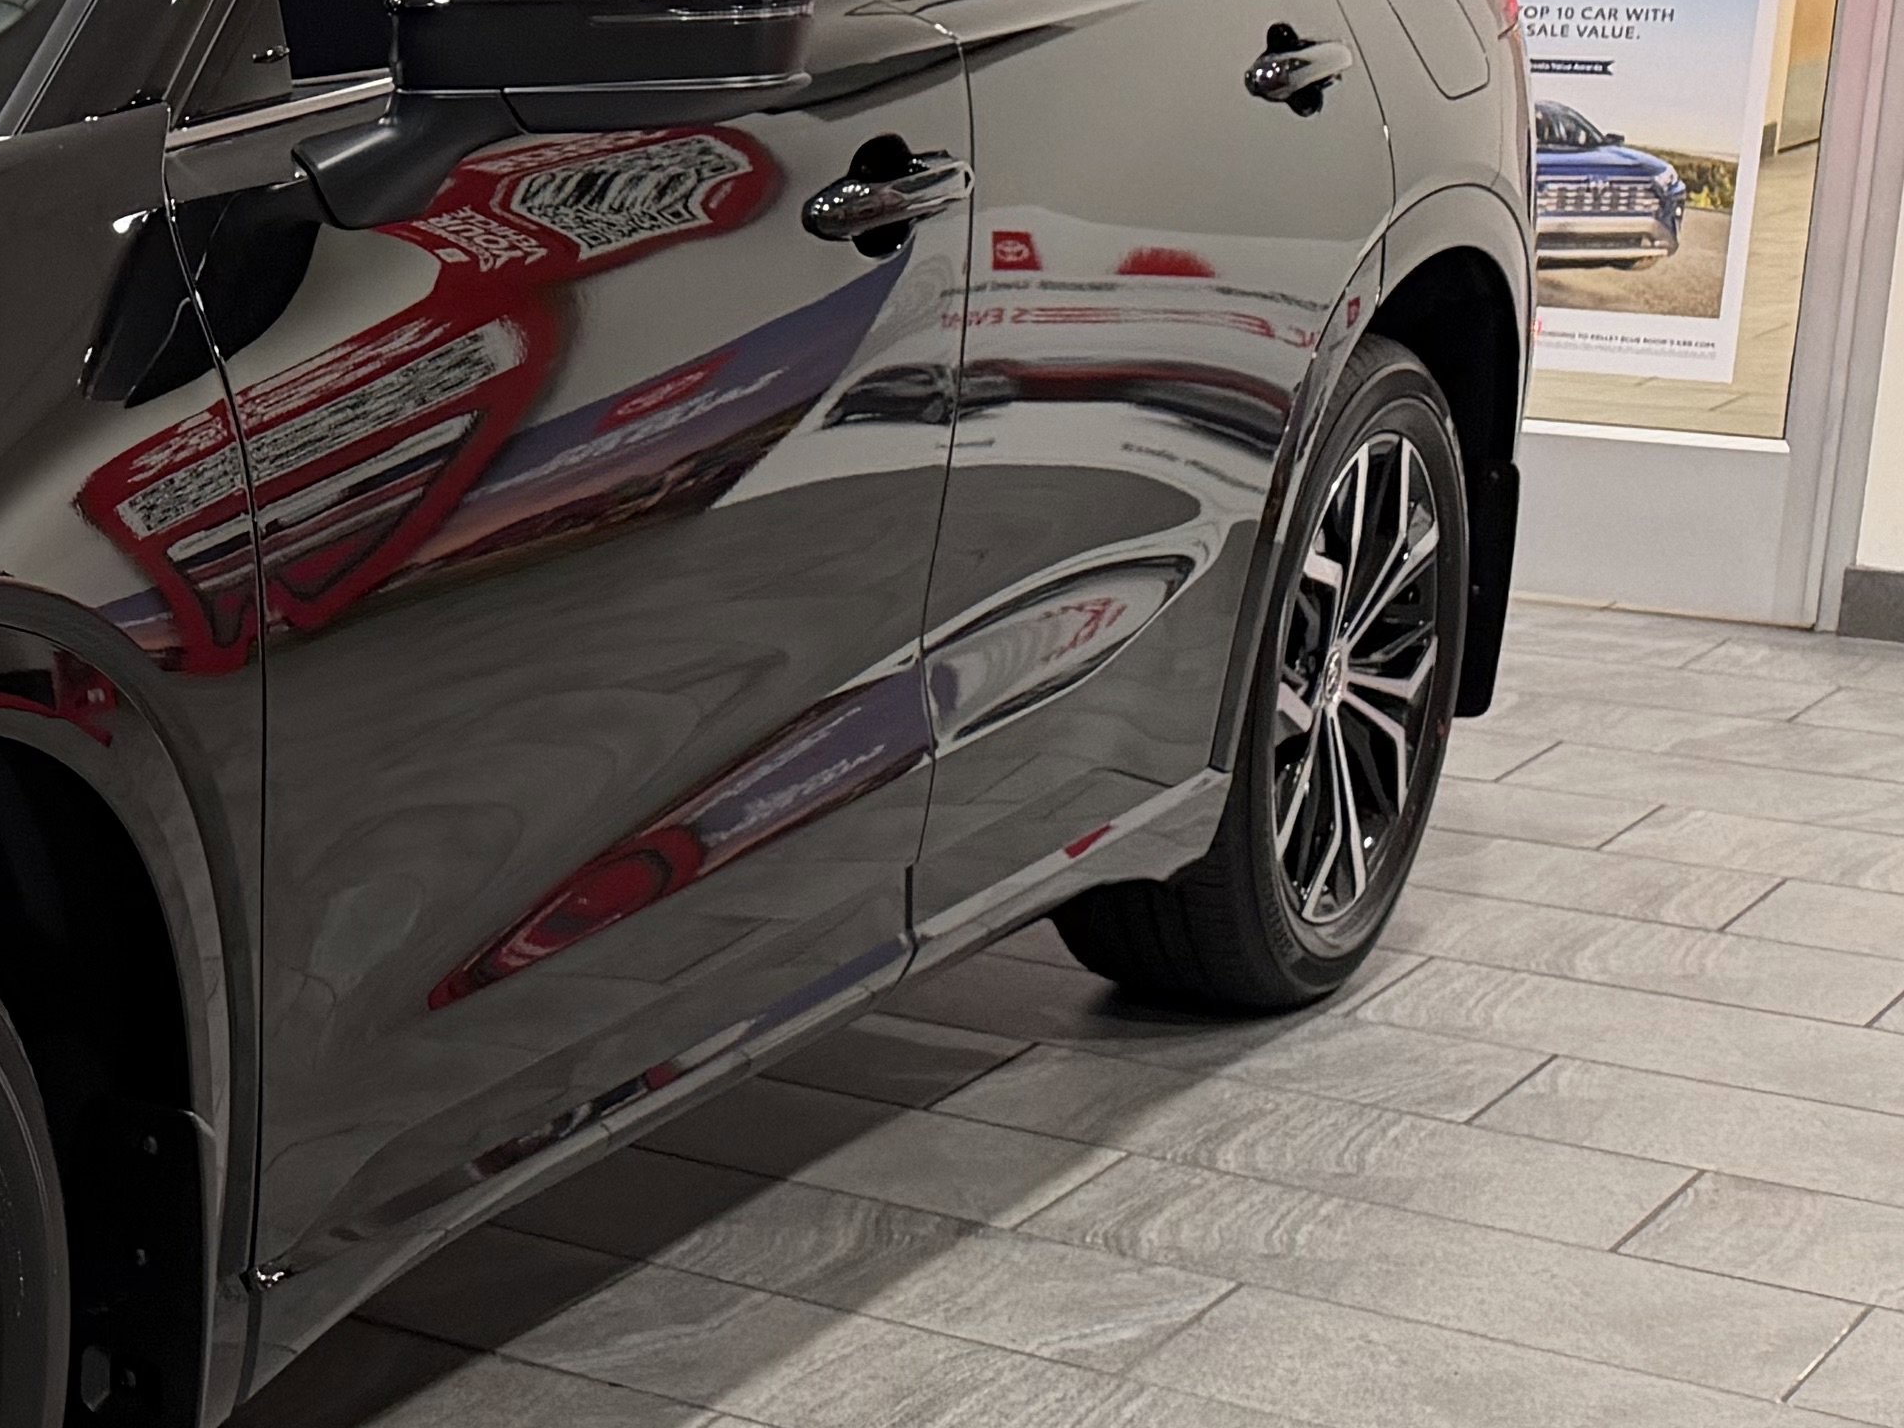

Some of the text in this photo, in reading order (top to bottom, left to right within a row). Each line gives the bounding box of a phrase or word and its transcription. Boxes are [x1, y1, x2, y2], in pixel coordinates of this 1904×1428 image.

[1557, 7, 1575, 20] 10
[1581, 7, 1618, 20] CAR
[1625, 8, 1675, 22] WITH
[1527, 23, 1641, 40] SALE VALUE.
